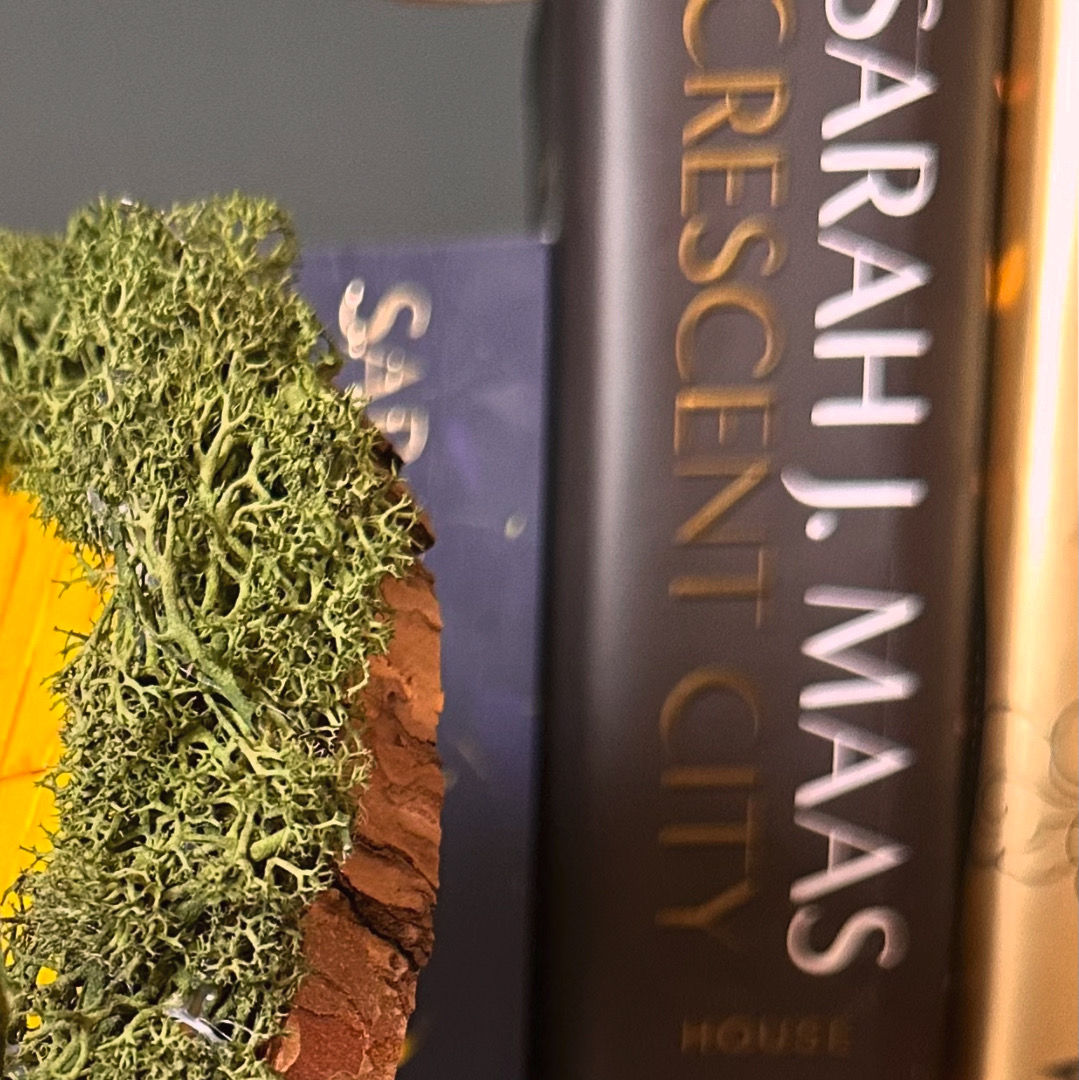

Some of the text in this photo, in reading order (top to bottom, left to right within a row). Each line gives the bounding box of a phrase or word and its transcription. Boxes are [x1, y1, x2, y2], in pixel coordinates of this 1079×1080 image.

[655, 0, 796, 948] CRESCENT CITY
[781, 0, 943, 977] SARAH J. MAAS
[681, 1014, 853, 1056] HOUSE
